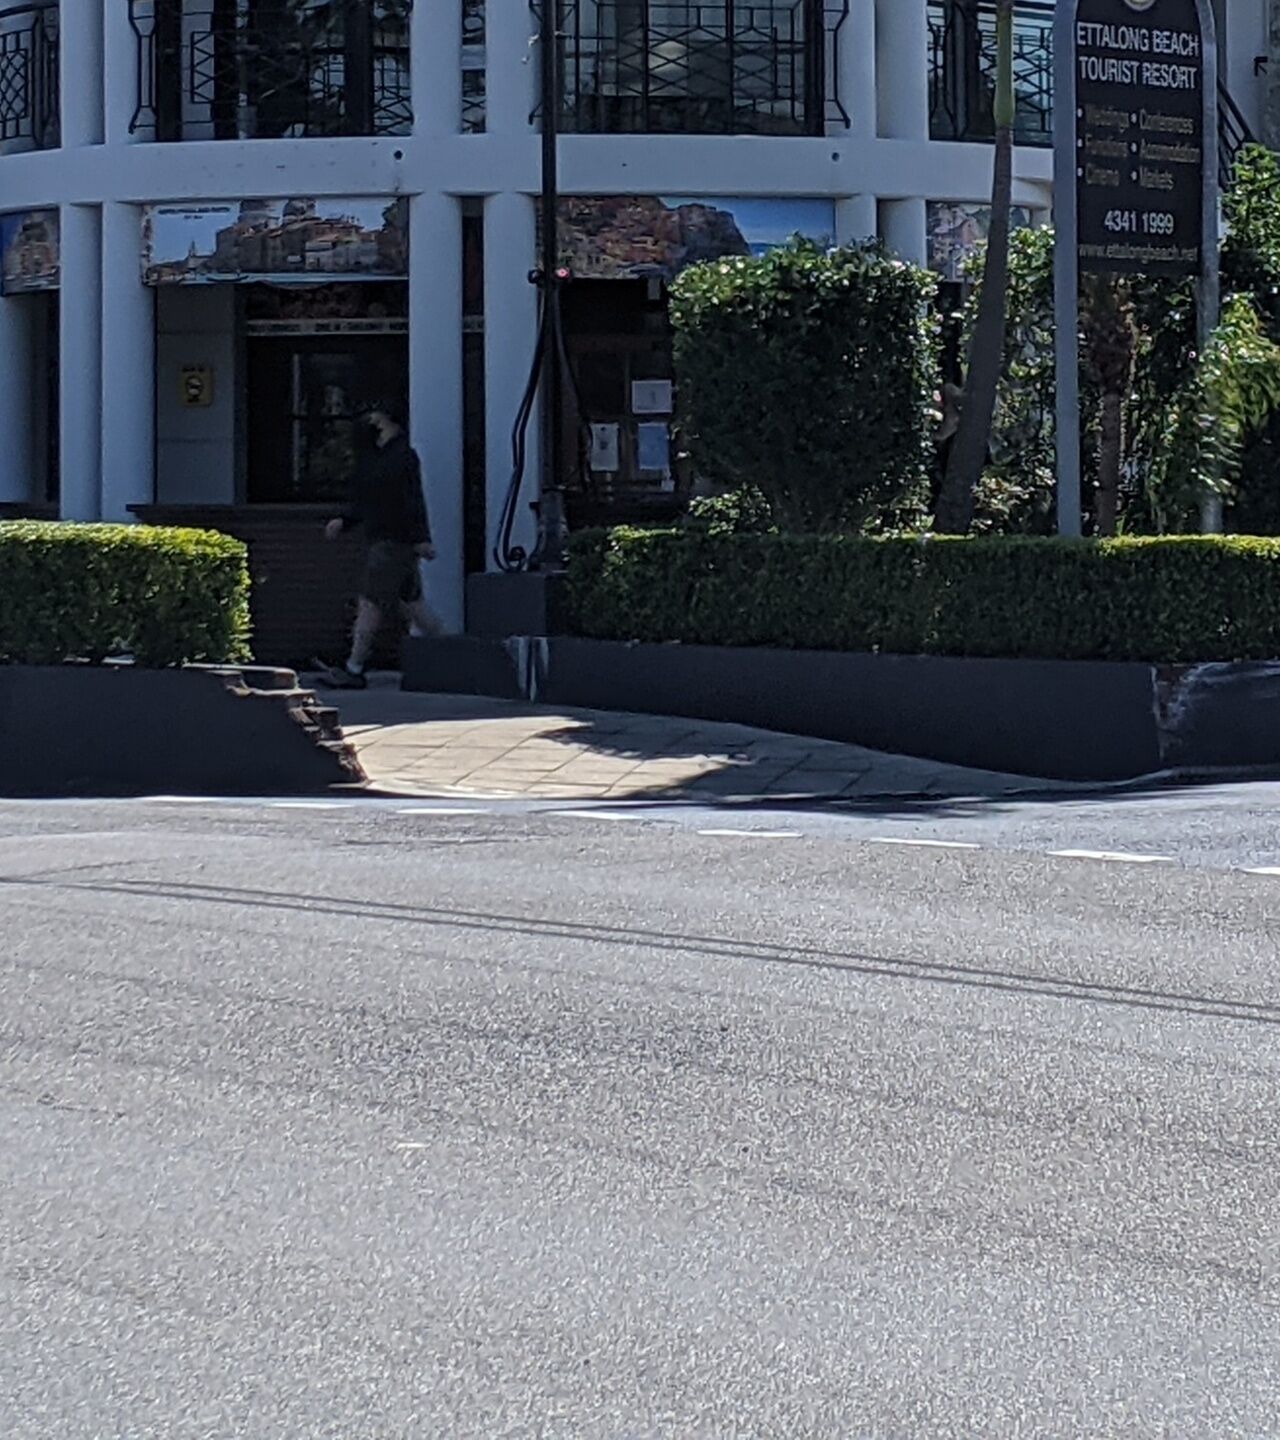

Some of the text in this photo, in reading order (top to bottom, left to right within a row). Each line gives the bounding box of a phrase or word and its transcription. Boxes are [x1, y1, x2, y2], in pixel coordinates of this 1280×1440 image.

[1077, 21, 1199, 57] ETTALONG BEACH
[1079, 56, 1197, 89] TOURIST RESORT
[1103, 209, 1174, 235] 4341 1999
